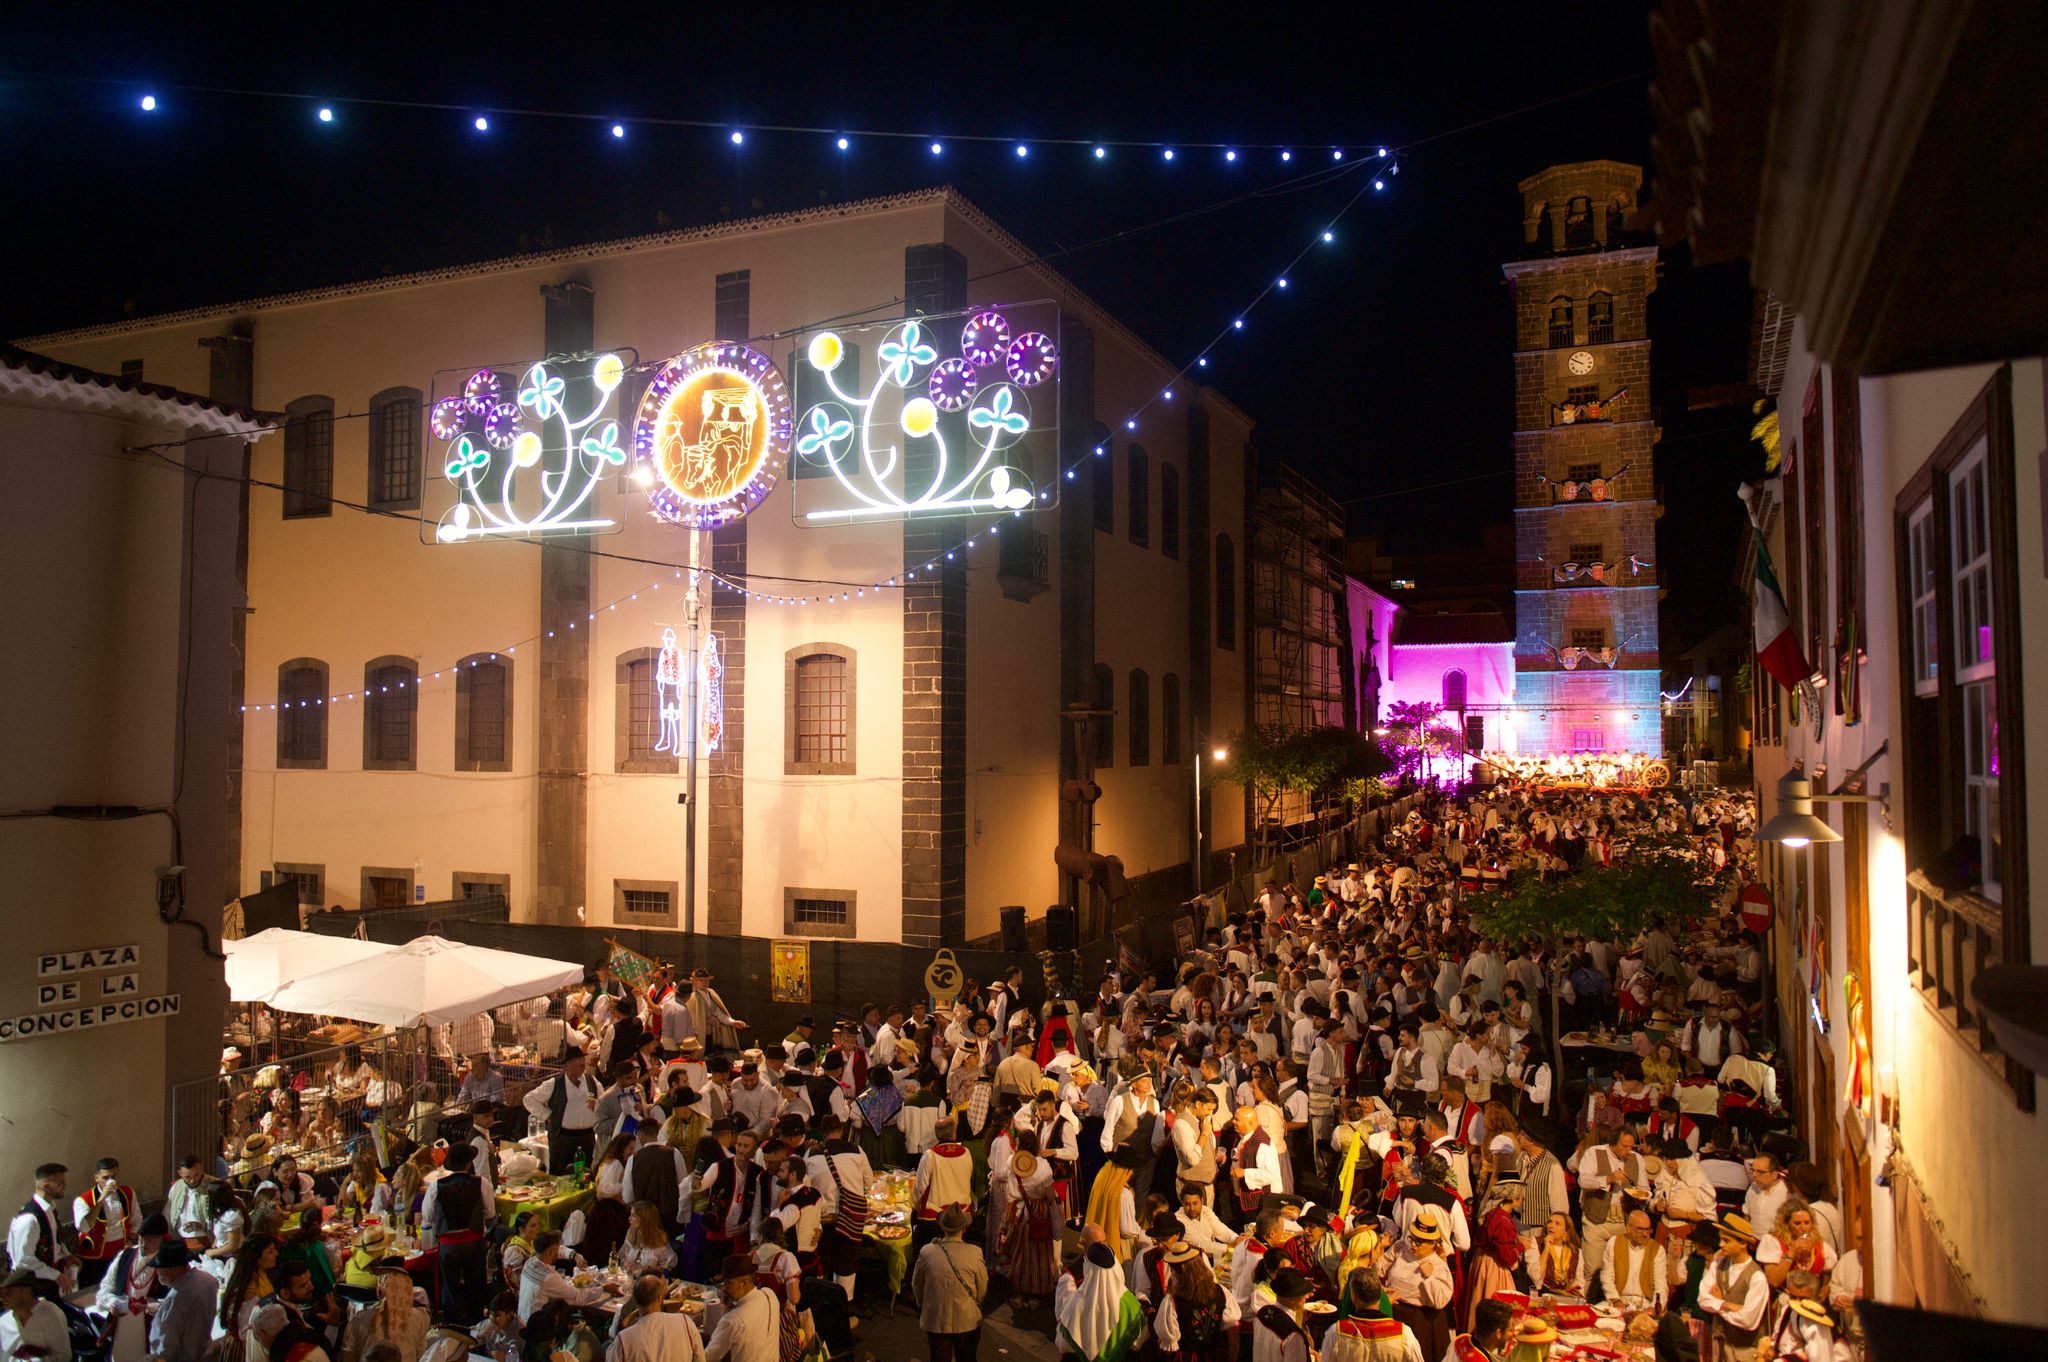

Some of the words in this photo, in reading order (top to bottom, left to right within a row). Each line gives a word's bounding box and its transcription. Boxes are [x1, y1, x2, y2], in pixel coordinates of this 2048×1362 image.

[41, 947, 136, 973] PLAZA
[40, 983, 77, 1003] DE
[103, 976, 136, 994] LA
[0, 996, 179, 1038] CONCEPCION
